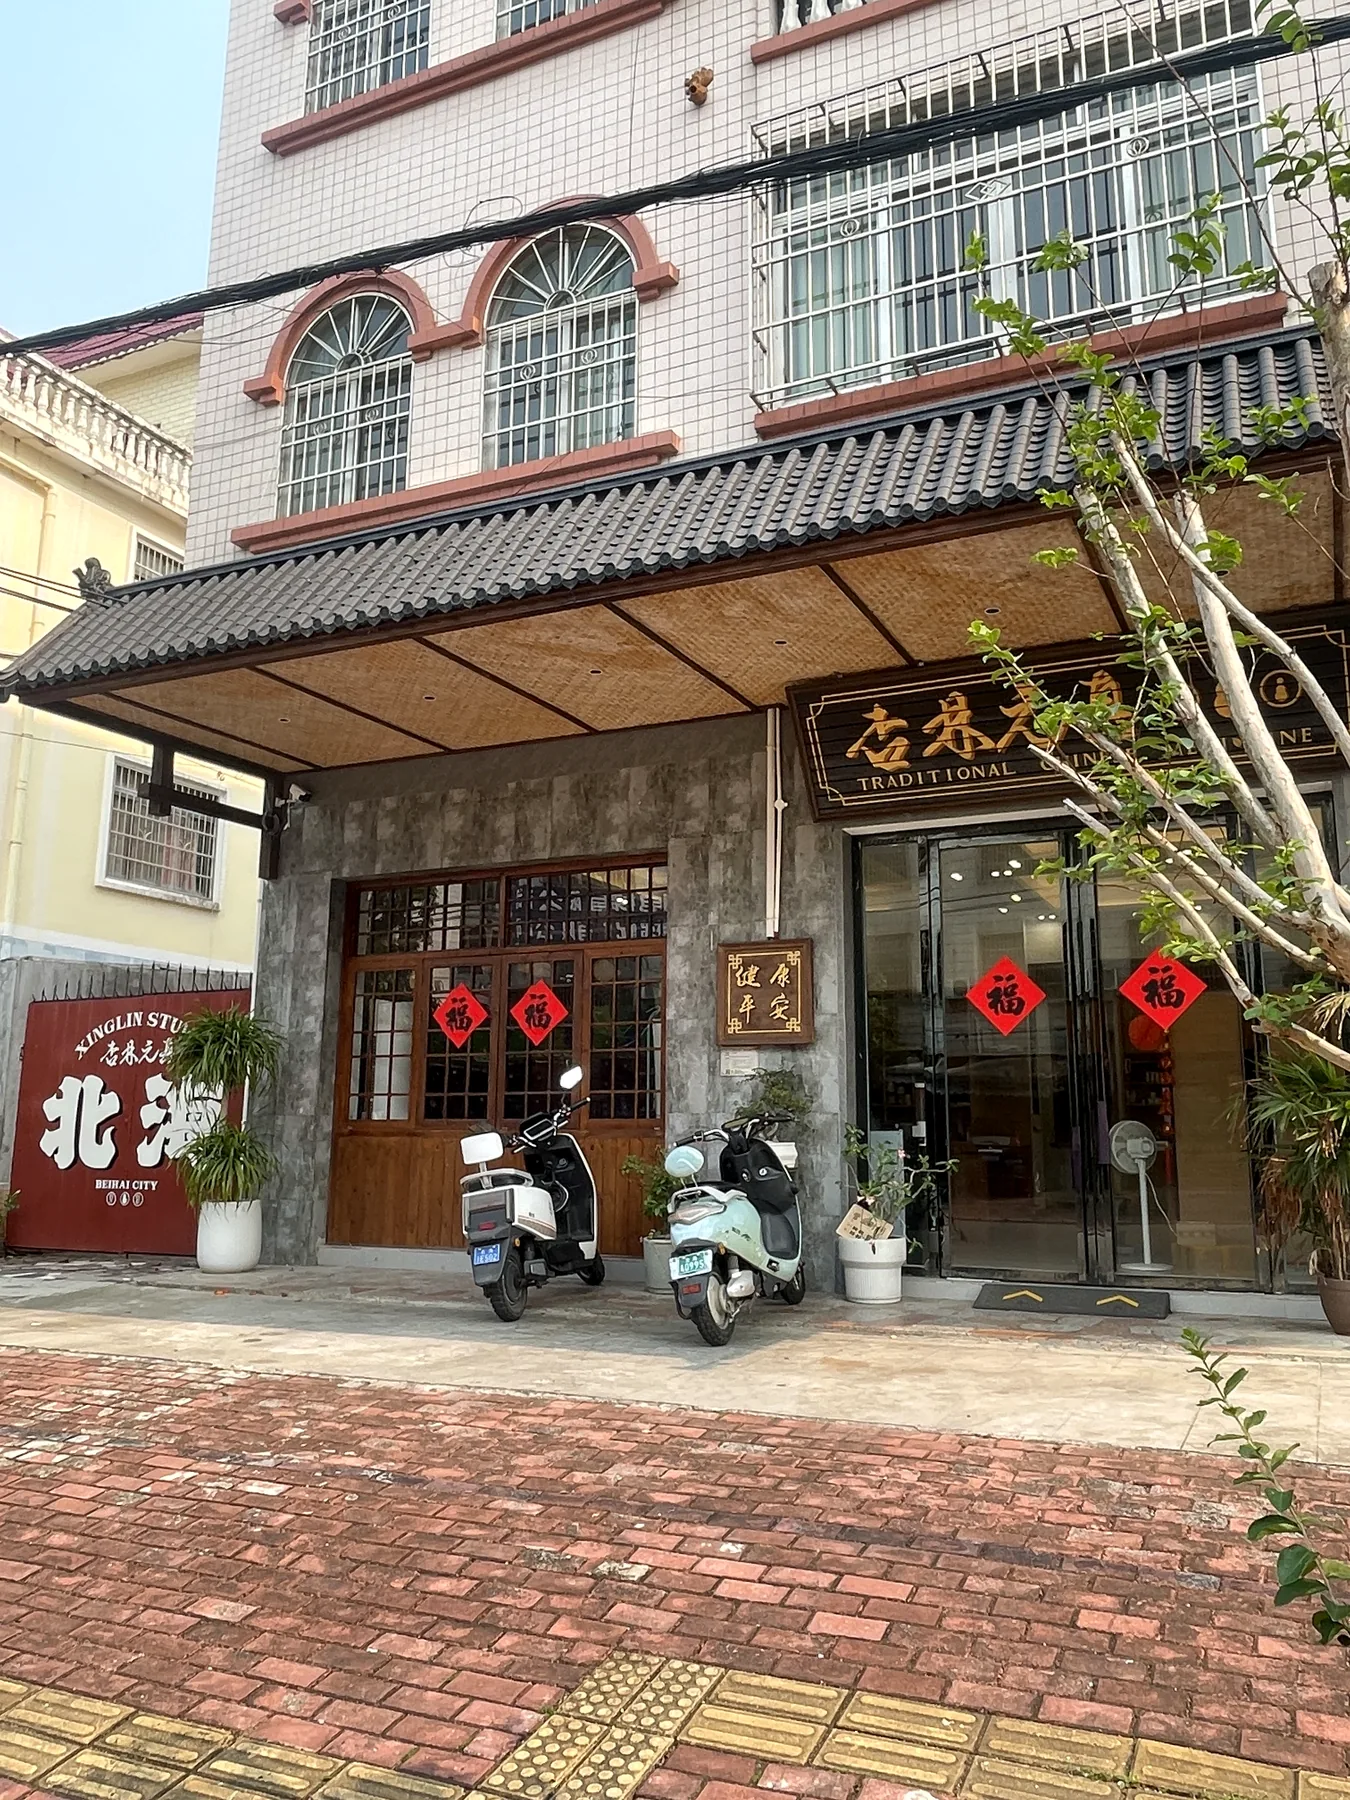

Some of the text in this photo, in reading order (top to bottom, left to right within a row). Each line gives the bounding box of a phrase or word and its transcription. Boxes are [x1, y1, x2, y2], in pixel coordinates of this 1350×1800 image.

[857, 761, 1016, 792] TRADITIONAL
[986, 973, 1026, 1017] 福
[1141, 964, 1186, 1010] 福
[445, 996, 474, 1033] 福
[524, 993, 553, 1031] 福
[738, 992, 790, 1024] 平安
[74, 1011, 144, 1061] XINGLIN
[95, 1179, 159, 1191] BEIHAI CITY
